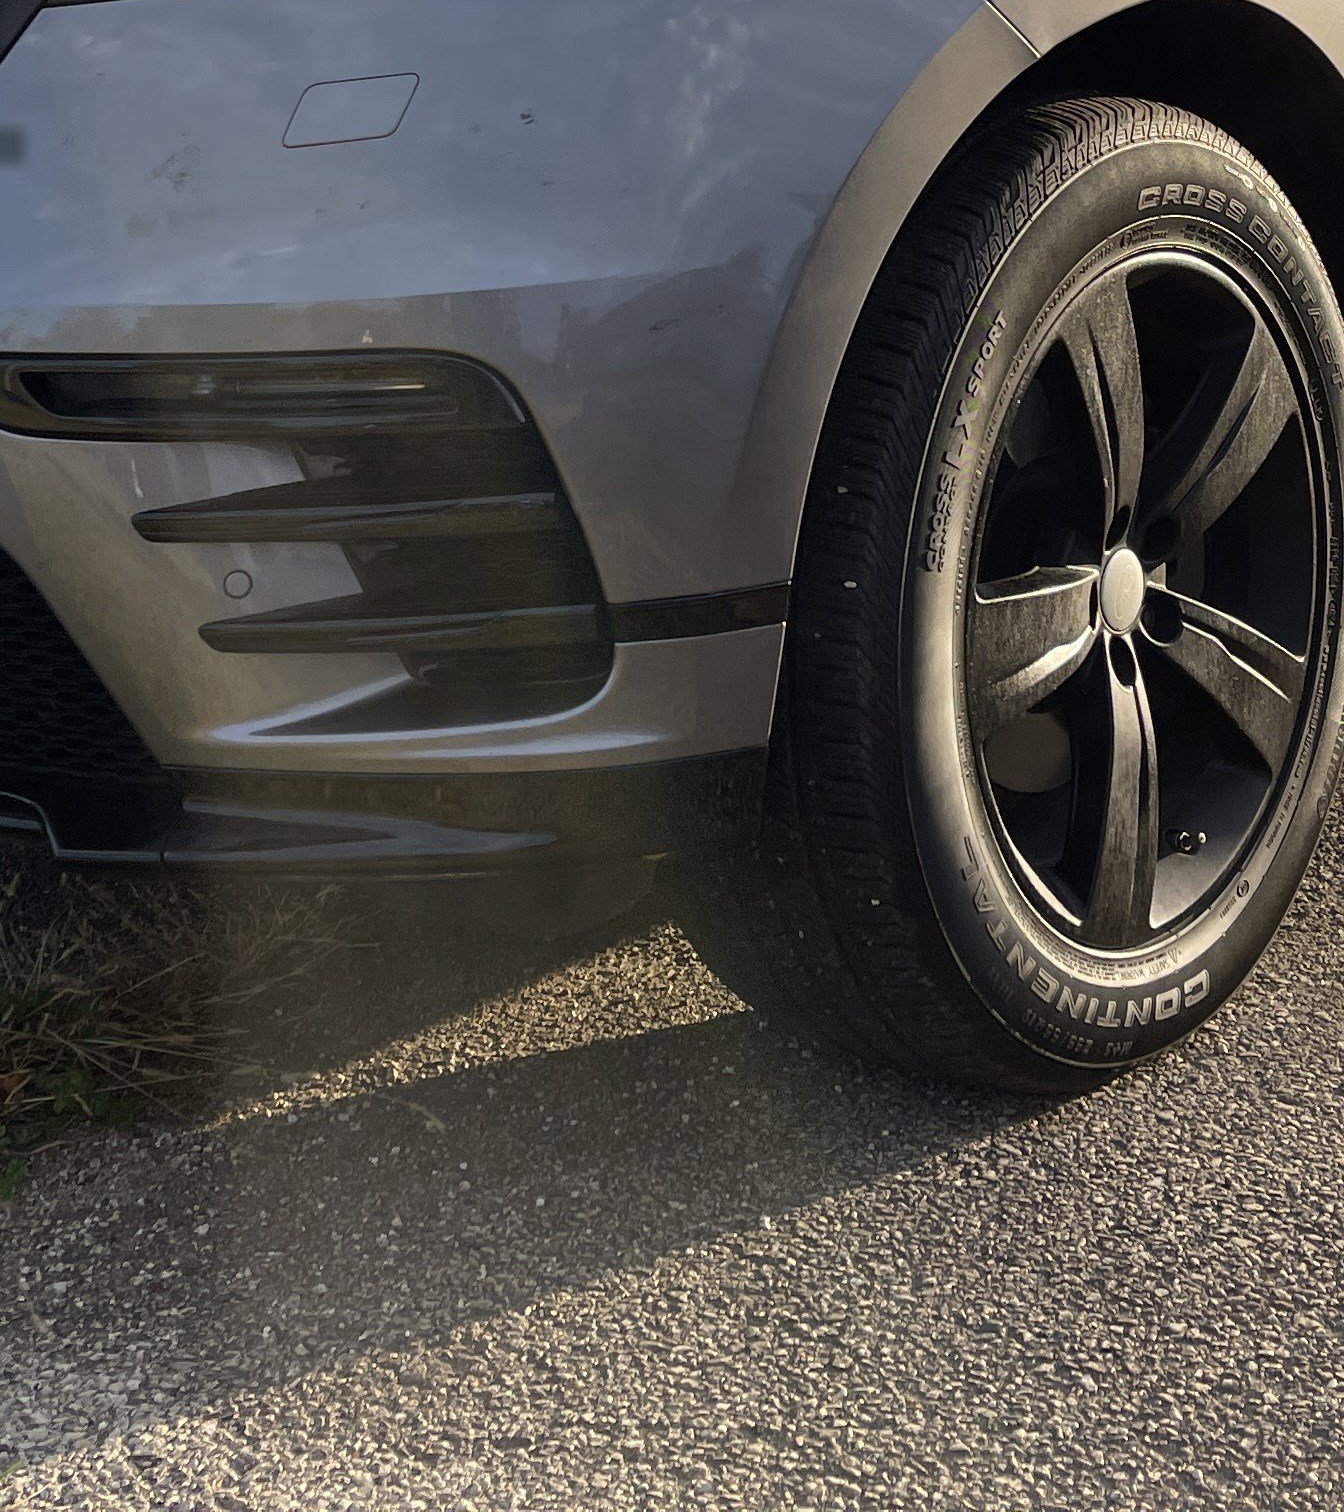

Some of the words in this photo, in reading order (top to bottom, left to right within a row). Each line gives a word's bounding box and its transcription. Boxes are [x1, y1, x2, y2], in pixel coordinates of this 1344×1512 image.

[1138, 183, 1248, 224] CROSS
[1247, 214, 1344, 390] CONTACT
[961, 835, 1211, 1029] CONTINENTAL
